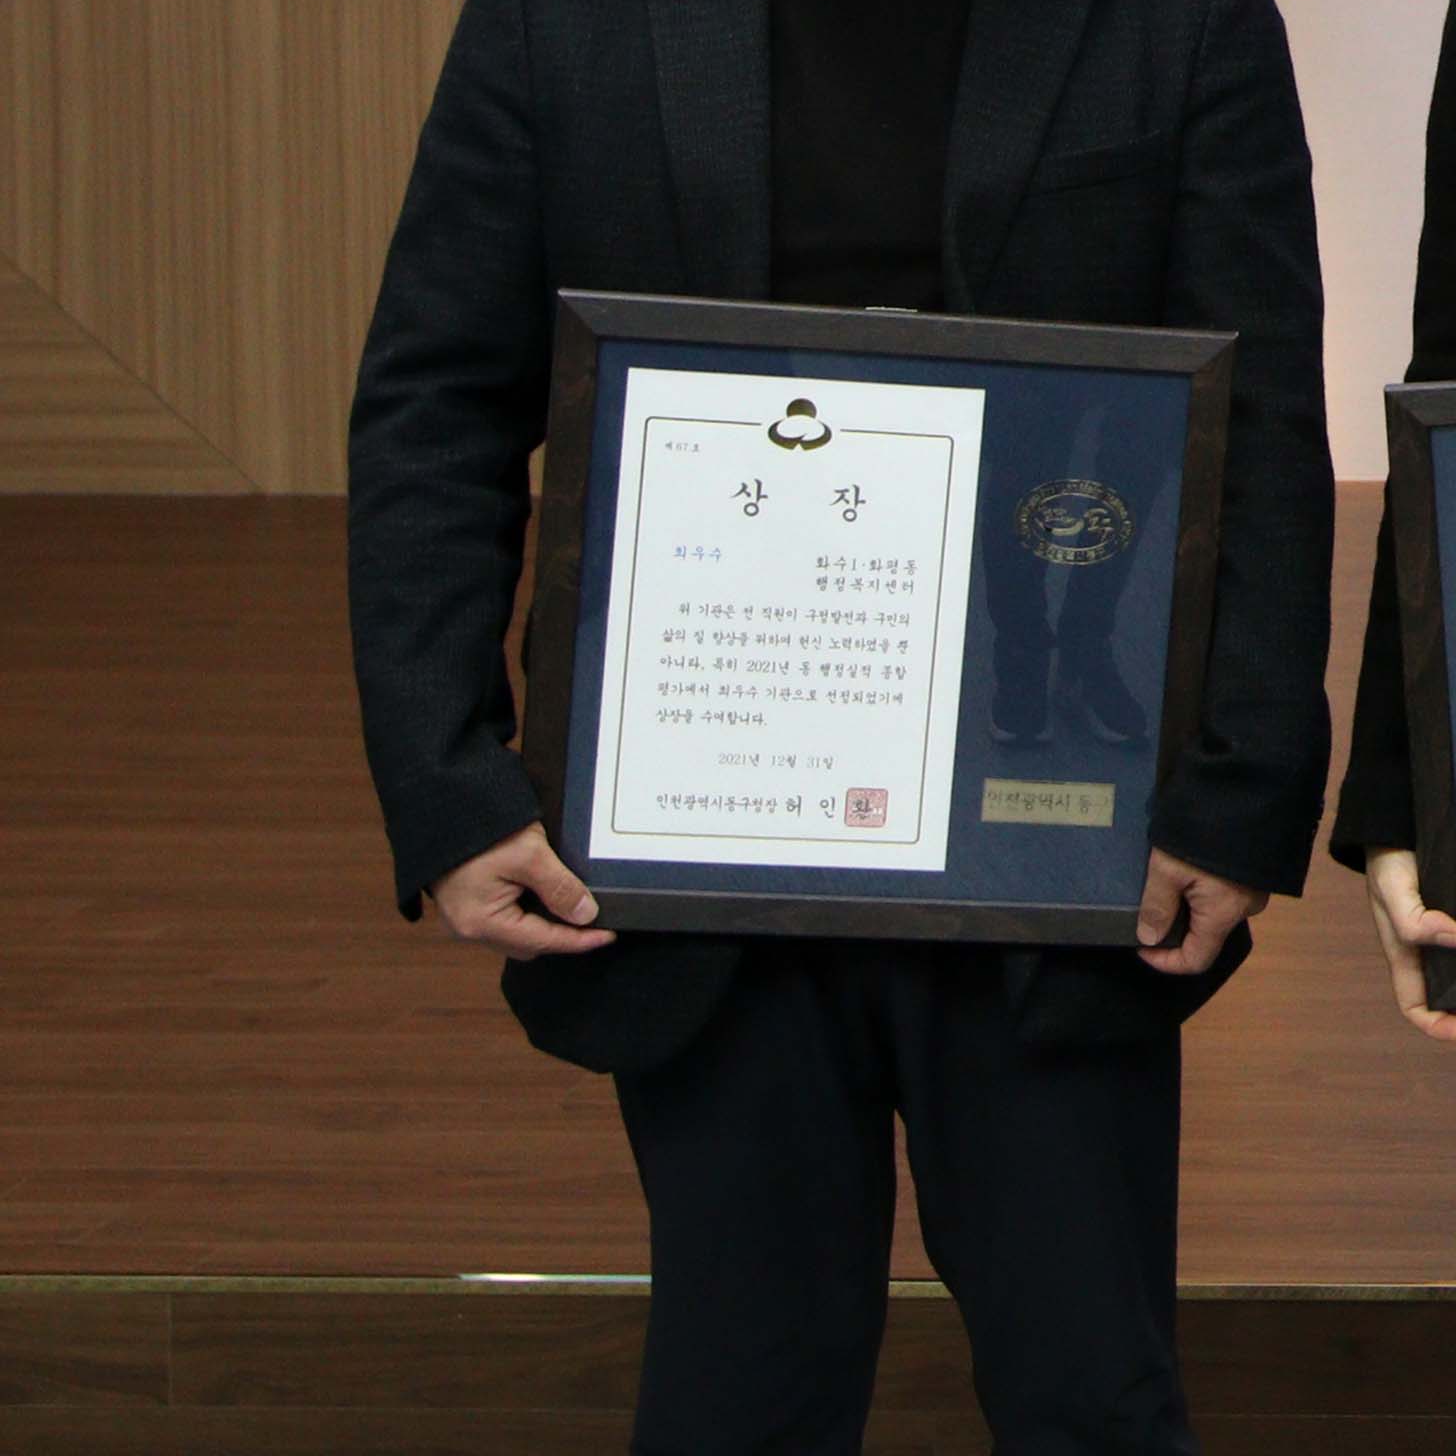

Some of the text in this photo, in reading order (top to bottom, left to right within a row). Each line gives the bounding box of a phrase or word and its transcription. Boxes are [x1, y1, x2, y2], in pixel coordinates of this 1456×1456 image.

[730, 478, 866, 522] 상 장
[746, 659, 790, 676] 2021년
[718, 752, 760, 768] 2021년
